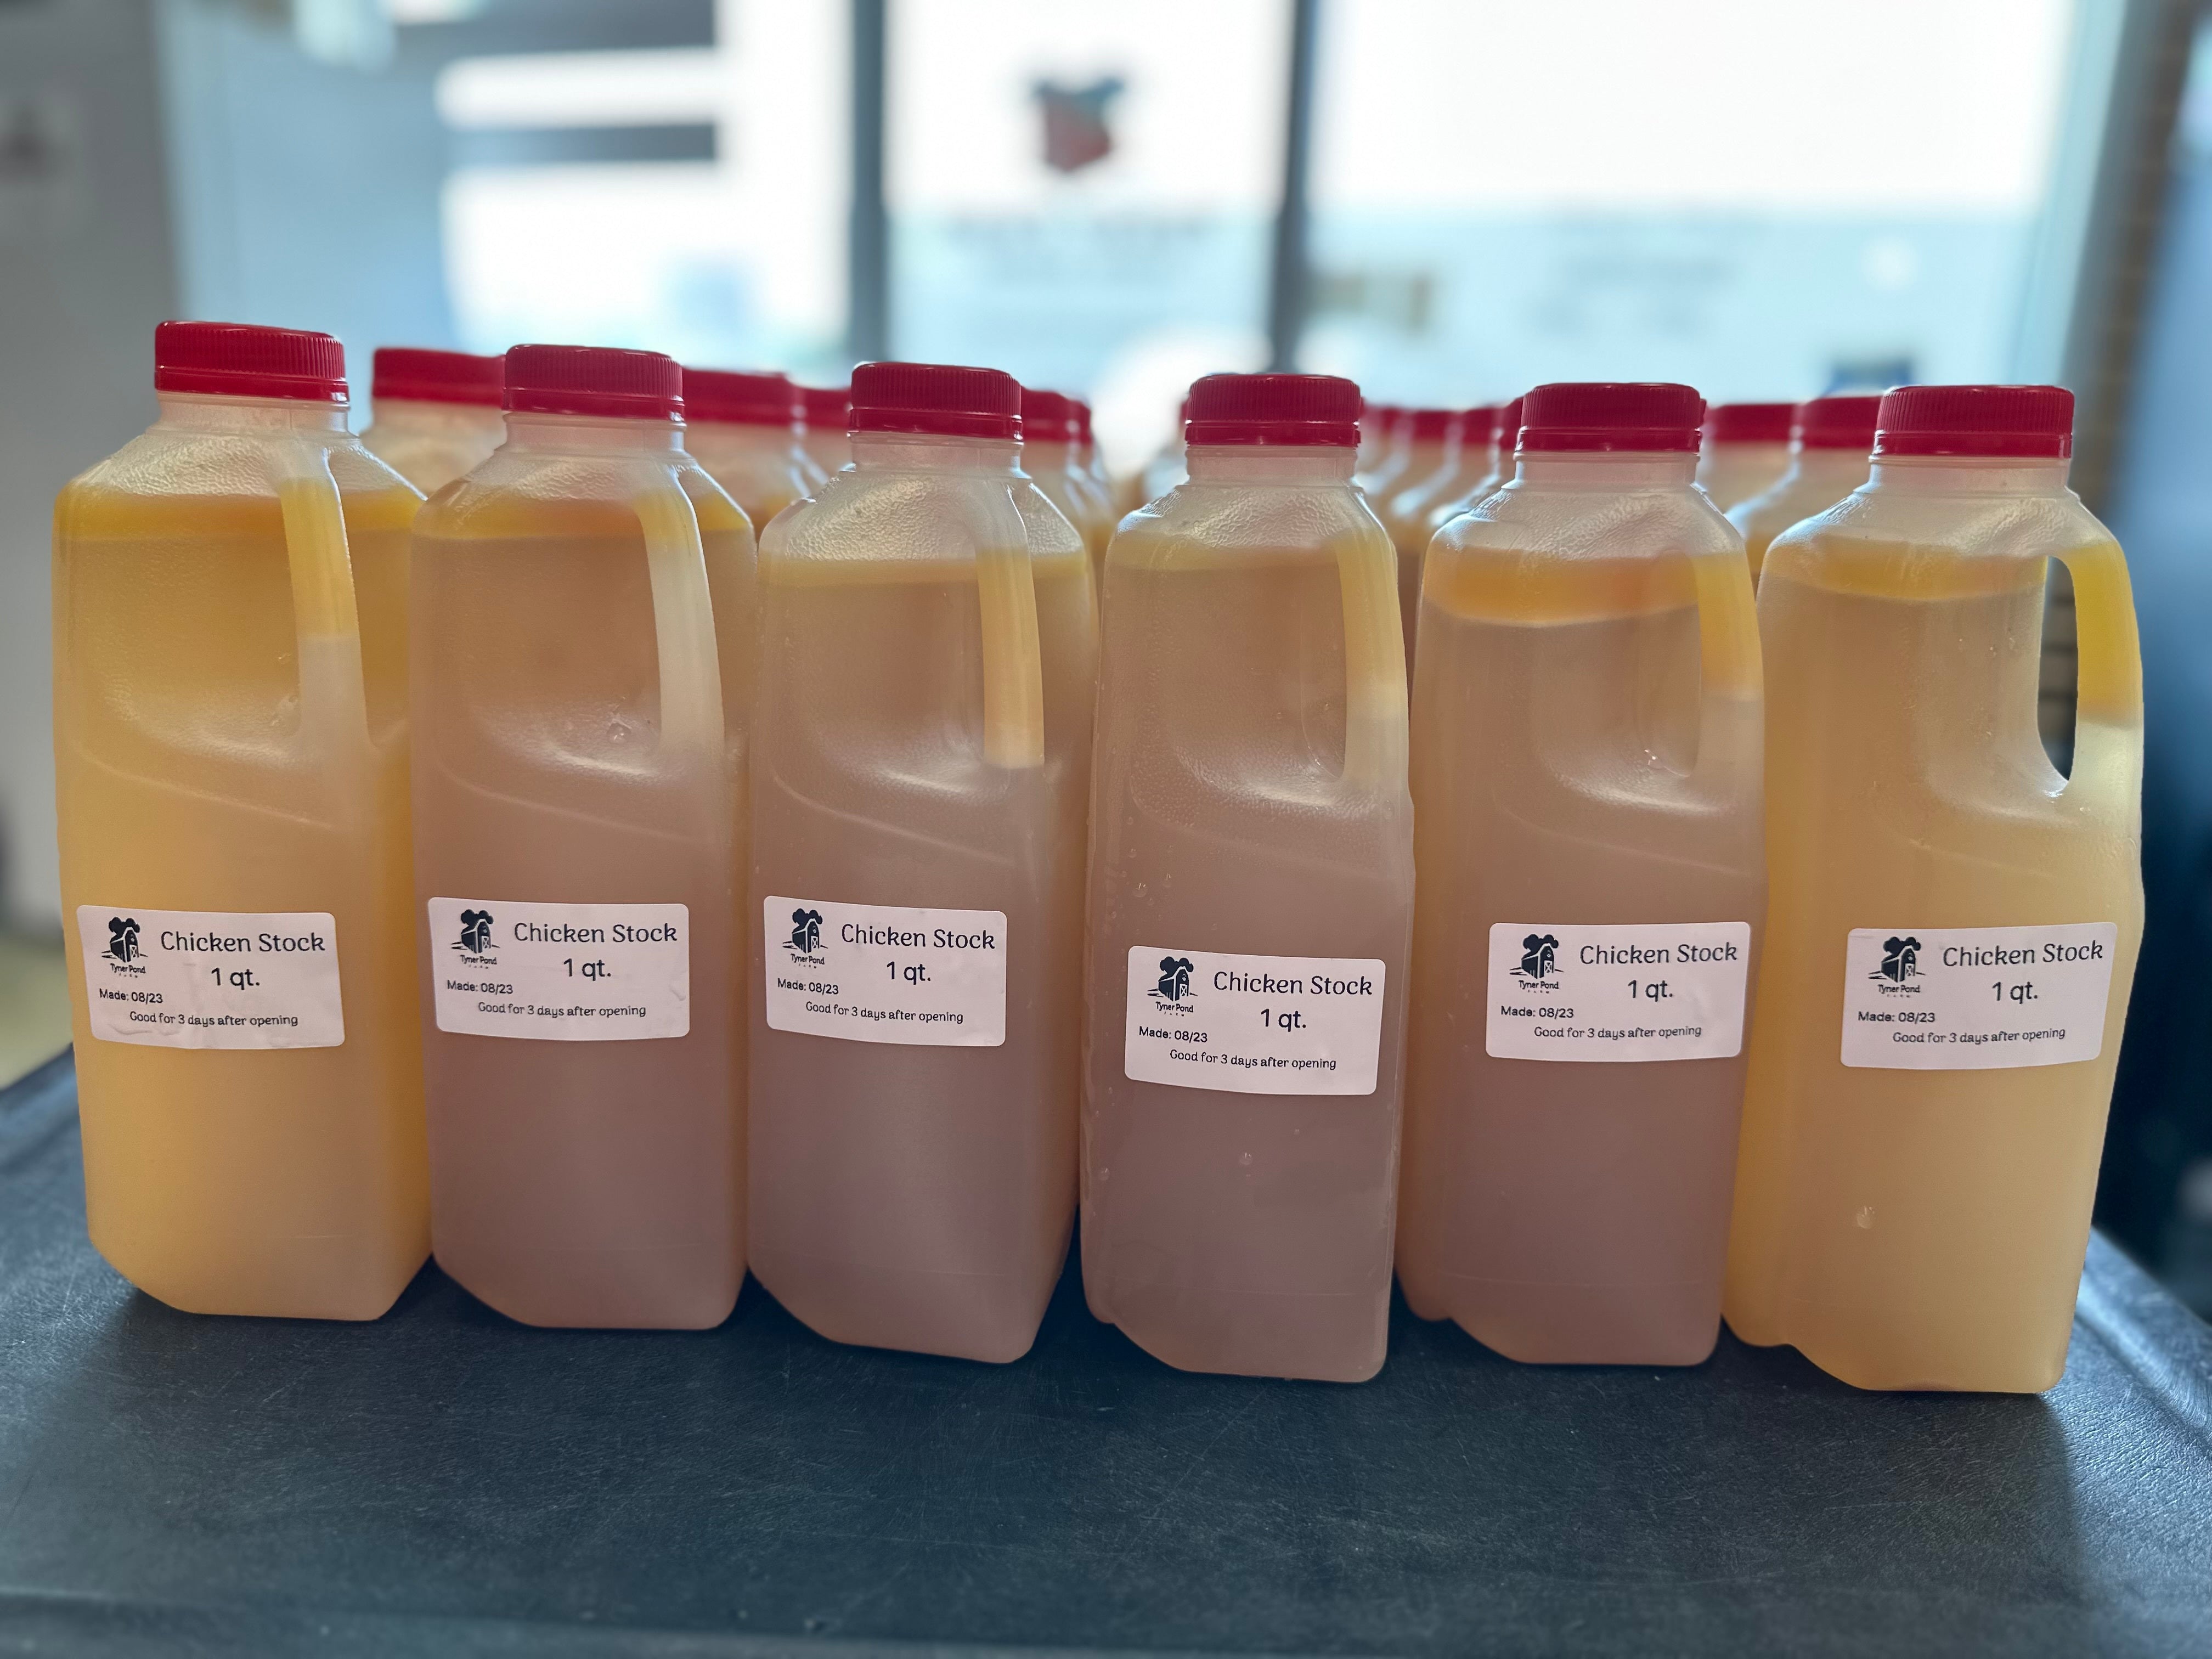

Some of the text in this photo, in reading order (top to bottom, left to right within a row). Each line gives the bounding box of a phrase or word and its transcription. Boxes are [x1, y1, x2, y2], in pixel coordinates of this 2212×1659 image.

[161, 931, 325, 952] Chicken Stock
[514, 922, 678, 943] Chicken Stock
[842, 924, 995, 950] Chicken Stock
[460, 955, 497, 964] Tyner Pond
[790, 953, 825, 965] Tyner Pond
[1580, 941, 1737, 964] Chicken Stock
[1943, 940, 2103, 967] Chicken Stock
[110, 963, 146, 974] Tyner Pond
[563, 958, 611, 981] 1 qt.
[887, 961, 930, 985] 1 qt.
[211, 967, 260, 990] 1 qt.
[447, 980, 513, 995] Made: 08/23
[777, 978, 839, 996] Made: 08/23
[1214, 971, 1372, 995] Chicken Stock
[1519, 980, 1560, 990] Tyner Pond
[99, 988, 163, 1005] Made: 08/23
[1628, 980, 1673, 1002] 1 qt.
[1877, 984, 1921, 994] Tyner Pond
[1992, 981, 2038, 1005] 1 qt.
[478, 1002, 646, 1018] Good for 3 days after opening
[806, 1001, 963, 1024] Good for 3 days after opening
[1155, 1001, 1194, 1013] Tyner Pond
[1501, 1006, 1574, 1021] Made: 08/23
[129, 1011, 298, 1028] Good for 3 days after opening
[1261, 1008, 1306, 1032] 1 qt.
[1858, 1011, 1936, 1025] Made: 08/23
[1139, 1026, 1207, 1044] Made: 08/23
[1534, 1026, 1702, 1041] Good for 3 days after opening
[1892, 1028, 2066, 1045] Good for 3 days after opening
[1170, 1049, 1336, 1070] Good for 3 days after opening
